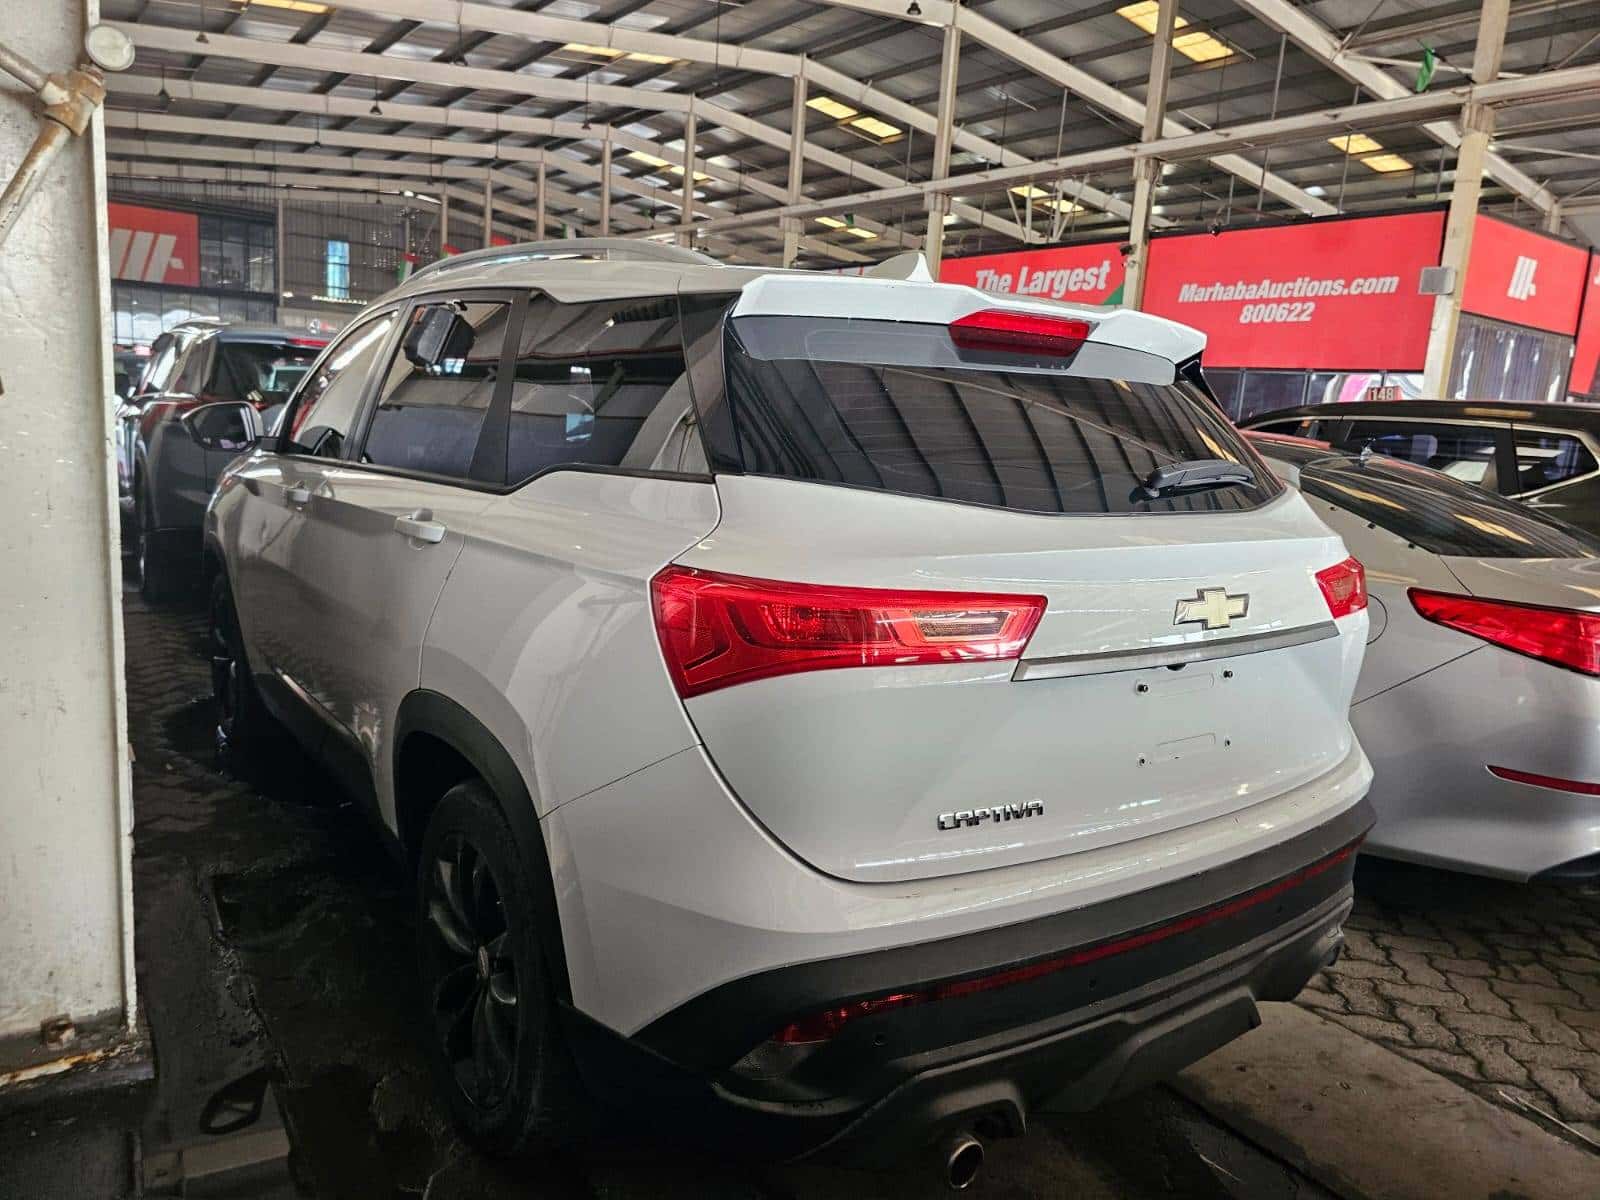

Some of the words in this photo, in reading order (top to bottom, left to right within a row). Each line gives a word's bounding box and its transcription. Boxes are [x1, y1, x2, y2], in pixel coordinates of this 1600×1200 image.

[976, 269, 1012, 293] The
[1016, 260, 1111, 299] Largest
[1178, 276, 1399, 303] MarhabaAuctions.com
[1239, 302, 1315, 323] 800622
[938, 800, 1044, 831] CAPTIVA
